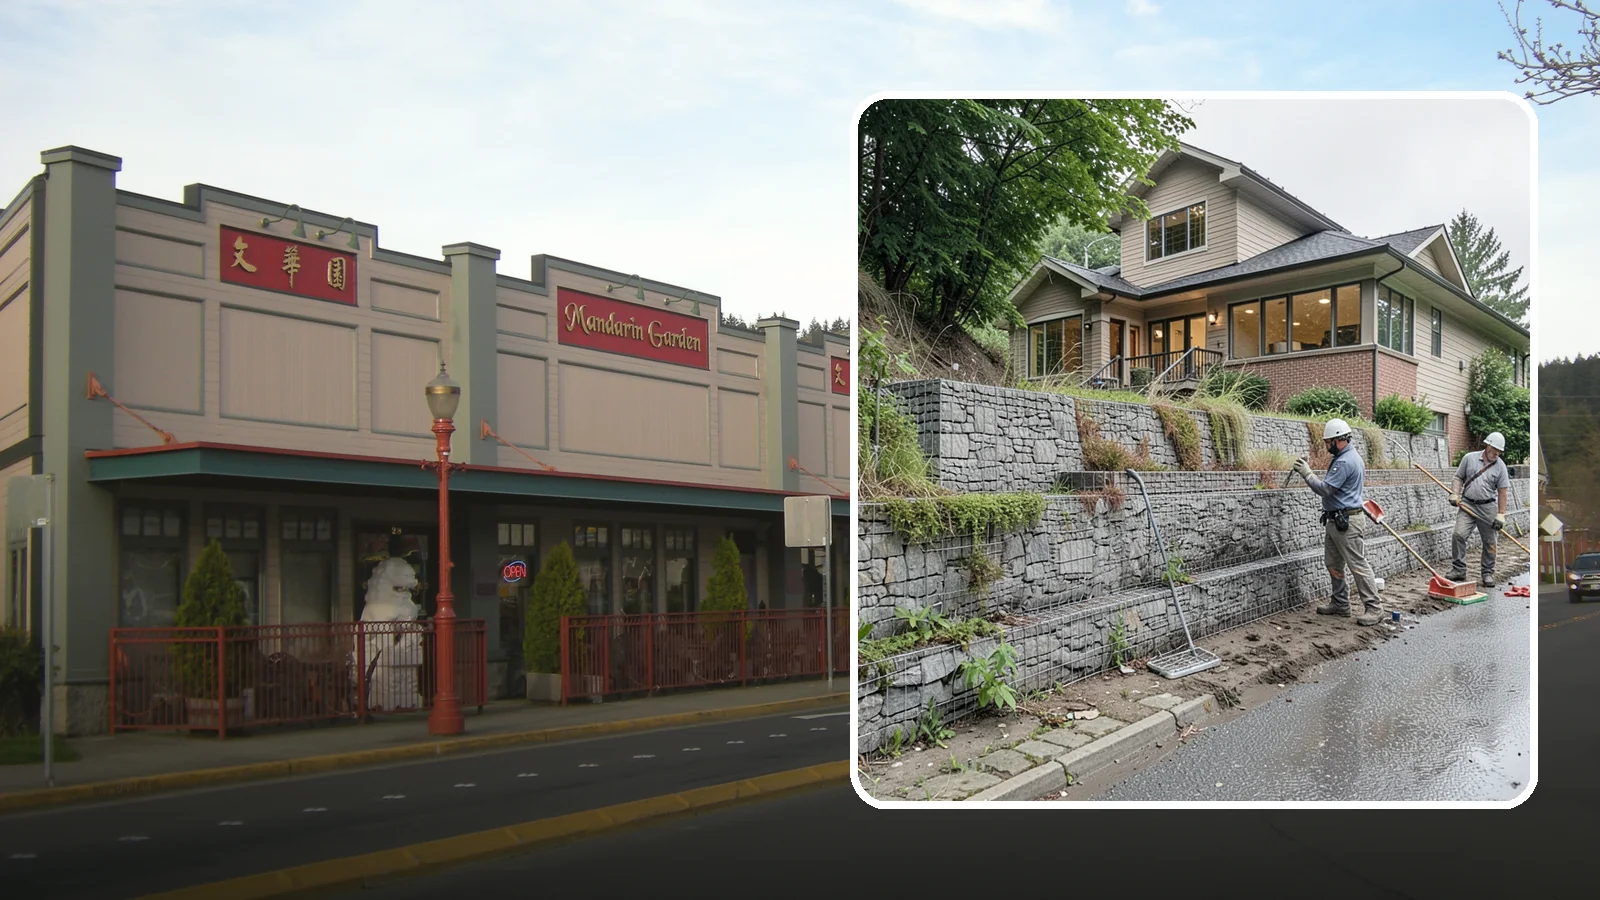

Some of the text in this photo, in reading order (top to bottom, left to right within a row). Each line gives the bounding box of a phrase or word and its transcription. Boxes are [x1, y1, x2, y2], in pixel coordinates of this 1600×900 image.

[231, 236, 346, 290] 文華園
[564, 302, 701, 352] Mandarin Garden
[503, 565, 527, 578] OPEN
